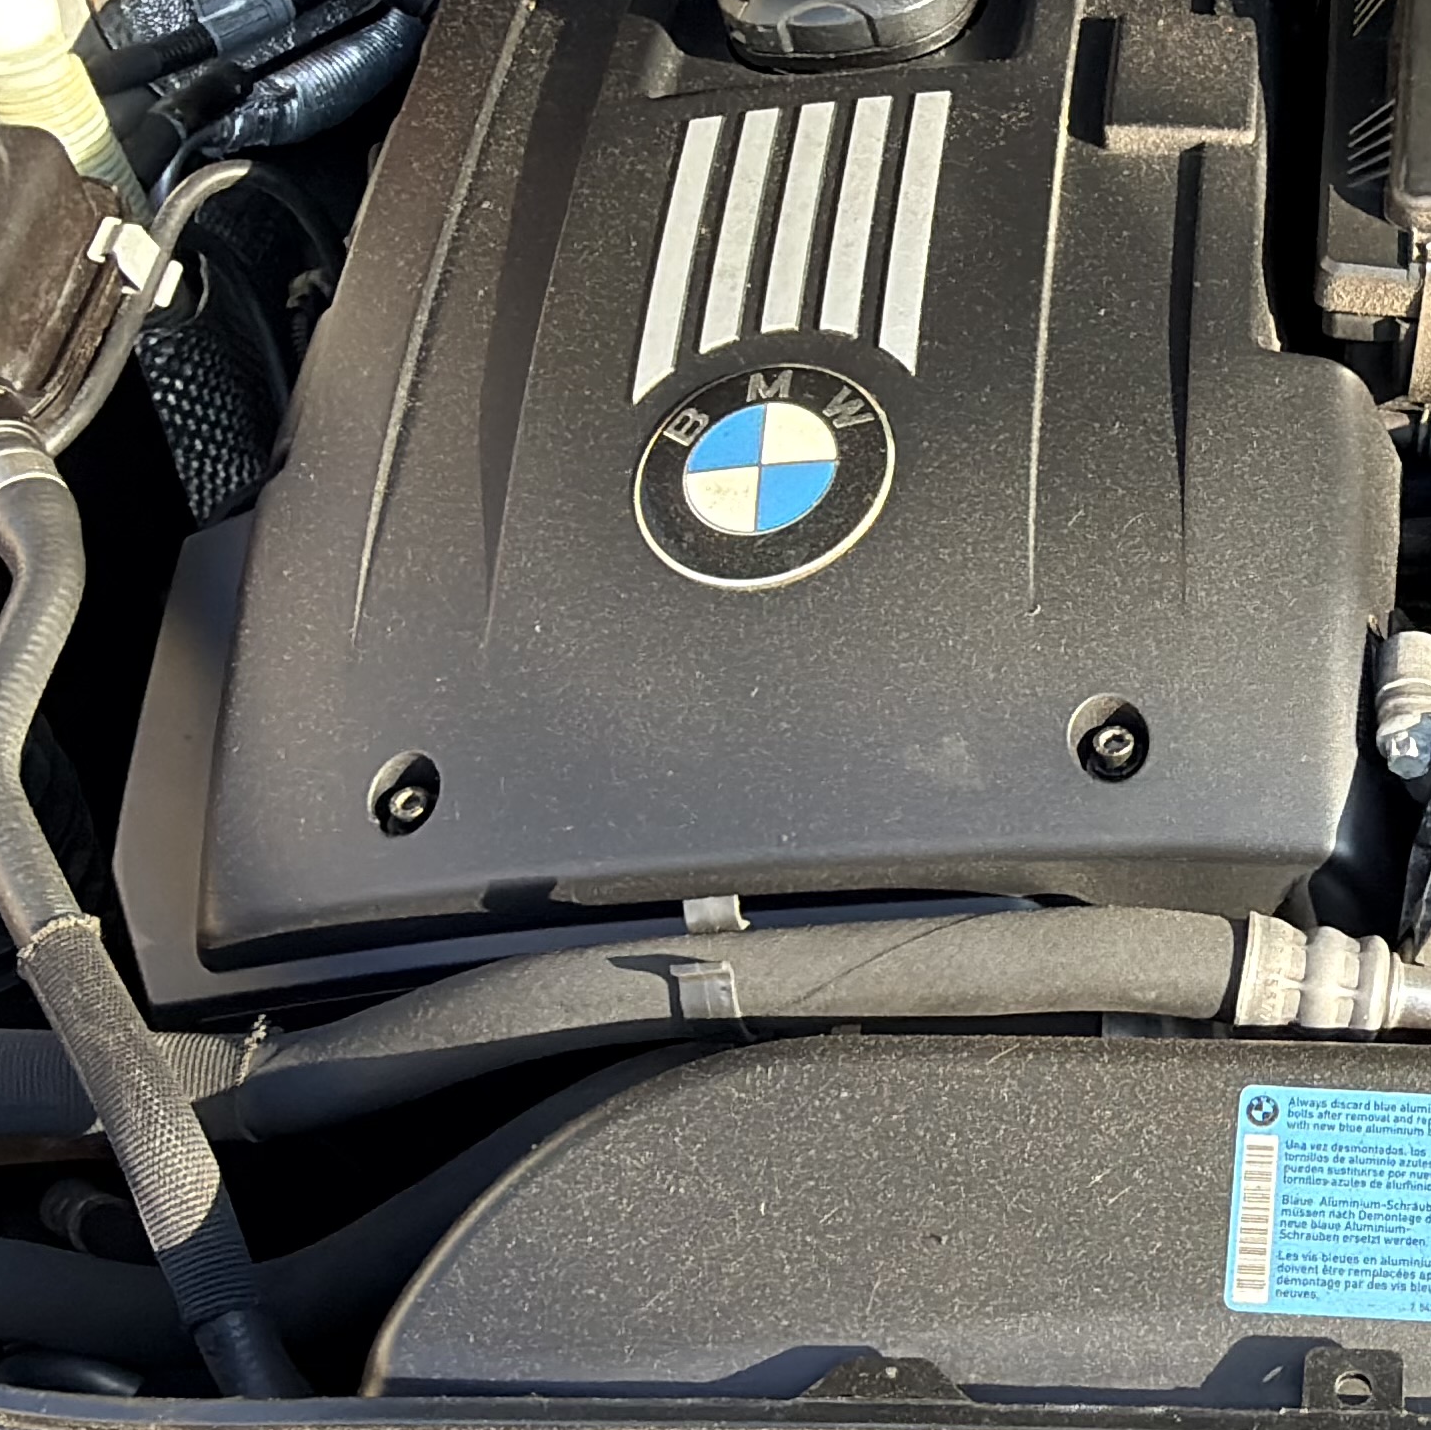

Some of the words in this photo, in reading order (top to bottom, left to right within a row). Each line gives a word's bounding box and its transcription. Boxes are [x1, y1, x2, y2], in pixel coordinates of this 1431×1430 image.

[663, 369, 875, 447] BMW
[1288, 1097, 1327, 1113] Always
[1331, 1099, 1370, 1111] discard
[1374, 1101, 1396, 1112] blue
[1318, 1110, 1342, 1120] after
[1346, 1112, 1390, 1122] removal
[1393, 1114, 1412, 1124] and
[1287, 1121, 1309, 1130] with
[1313, 1122, 1335, 1132] new
[1339, 1122, 1362, 1133] blue
[1365, 1125, 1424, 1136] aluminium
[1333, 1153, 1345, 1163] de
[1349, 1155, 1396, 1167] aluminio
[1388, 1169, 1407, 1180] por
[1370, 1177, 1383, 1189] de
[1282, 1195, 1313, 1206] Blaue
[1329, 1210, 1355, 1219] nach
[1358, 1211, 1422, 1225] Demontage
[1280, 1220, 1307, 1229] neue
[1311, 1220, 1341, 1231] blaue
[1279, 1229, 1339, 1243] Schrauben
[1343, 1233, 1381, 1244] ersetzt
[1278, 1250, 1298, 1261] Les
[1363, 1257, 1377, 1265] en
[1344, 1279, 1364, 1290] par
[1367, 1279, 1387, 1290] des
[1391, 1280, 1406, 1291] vis
